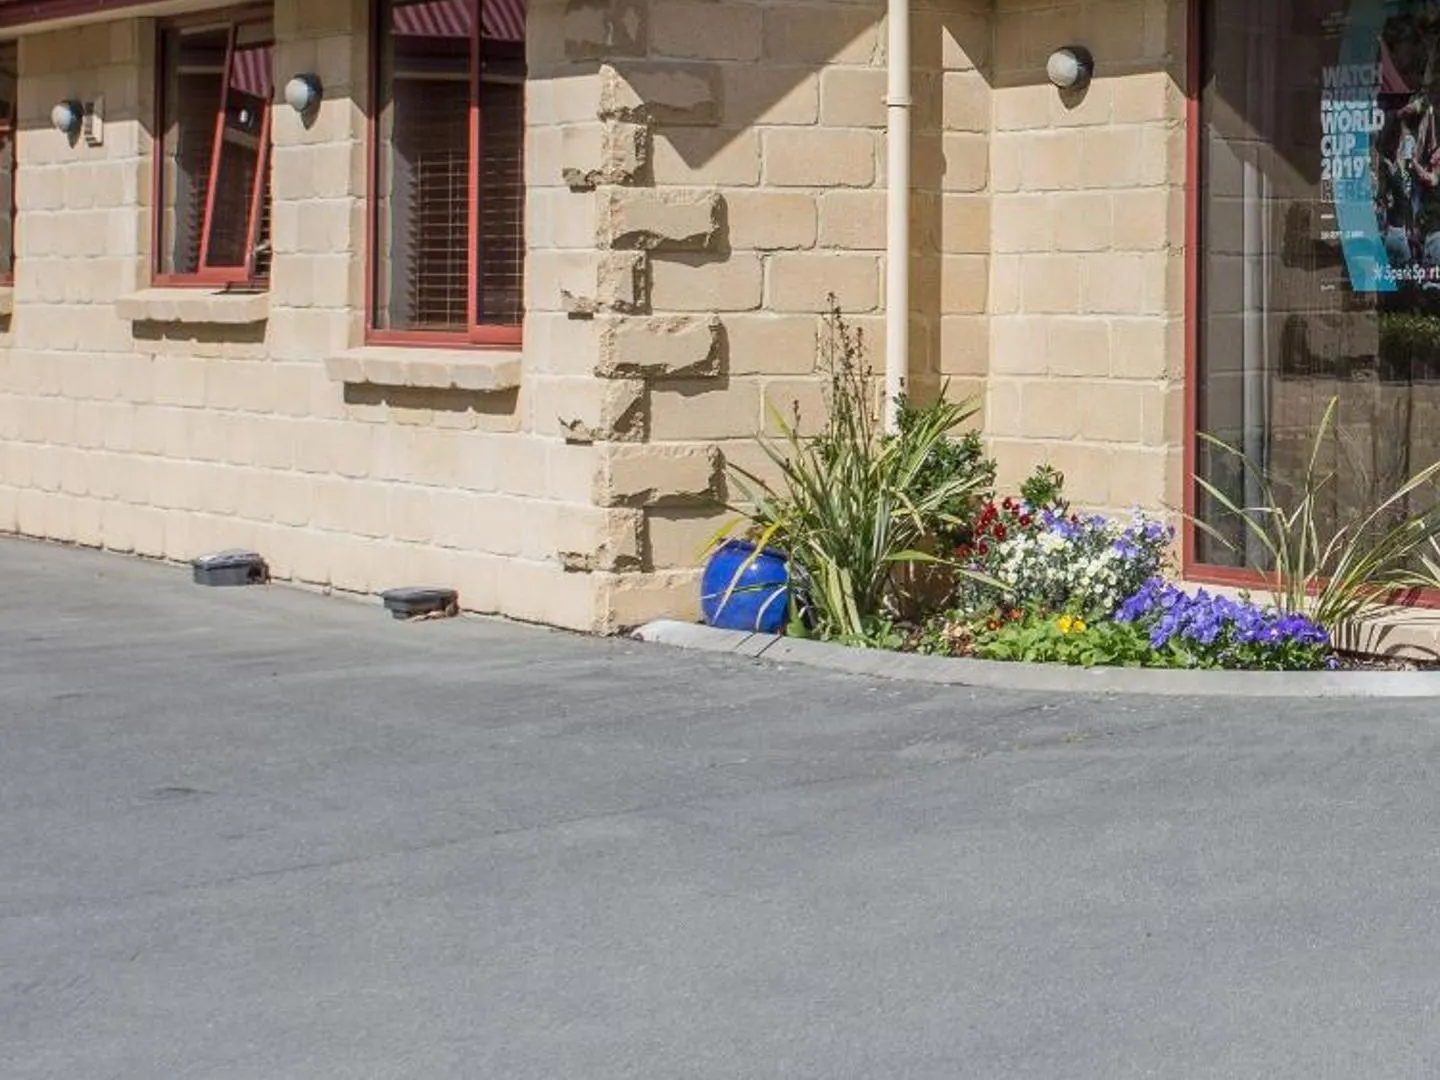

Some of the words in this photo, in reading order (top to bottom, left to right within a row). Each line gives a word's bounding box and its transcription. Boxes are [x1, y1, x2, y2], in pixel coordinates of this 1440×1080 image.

[1322, 64, 1383, 88] WATCH
[1321, 108, 1385, 134] WORLD
[1321, 133, 1356, 157] CUP
[1321, 155, 1365, 180] 2019
